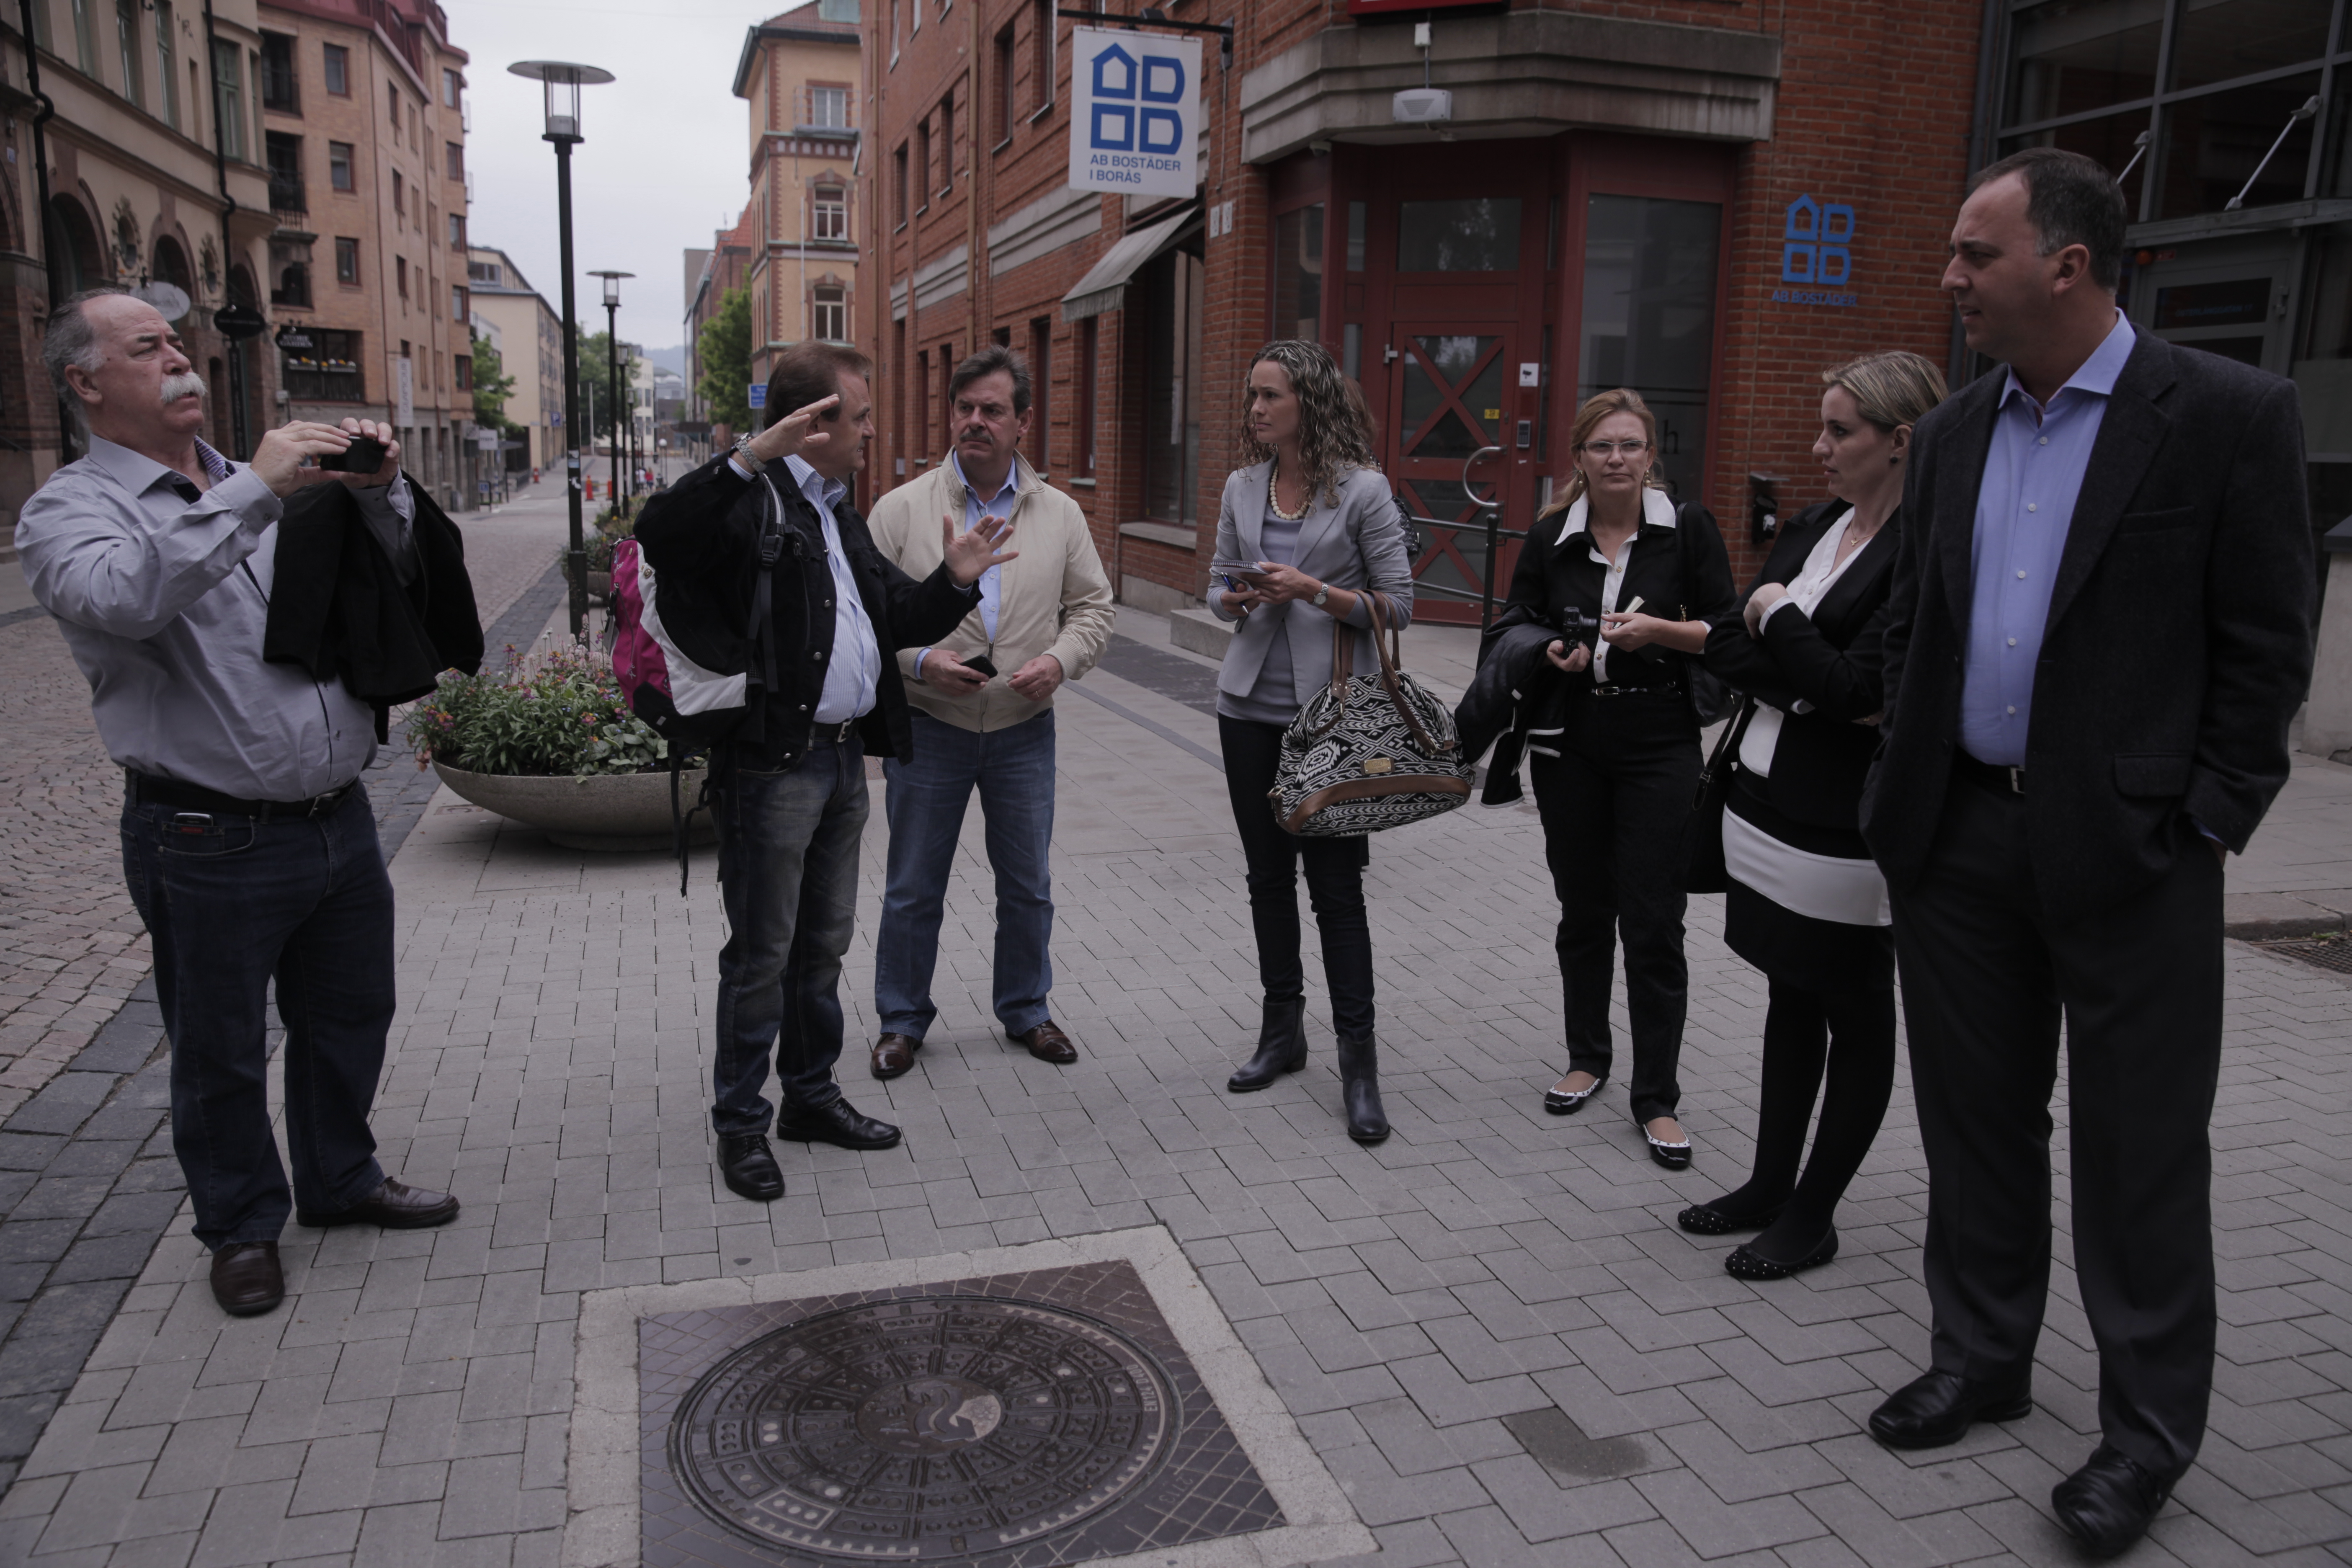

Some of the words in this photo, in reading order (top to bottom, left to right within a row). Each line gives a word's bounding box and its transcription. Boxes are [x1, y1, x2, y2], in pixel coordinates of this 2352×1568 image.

[1090, 154, 1108, 165] AB
[1112, 155, 1181, 171] BOSTÄDER
[1090, 170, 1093, 180] I
[1096, 169, 1141, 183] BORÅS
[1772, 290, 1789, 302] AB
[1791, 290, 1857, 307] BOSTÄDER
[1126, 1364, 1150, 1384] D400
[1139, 1386, 1158, 1411] EN124
